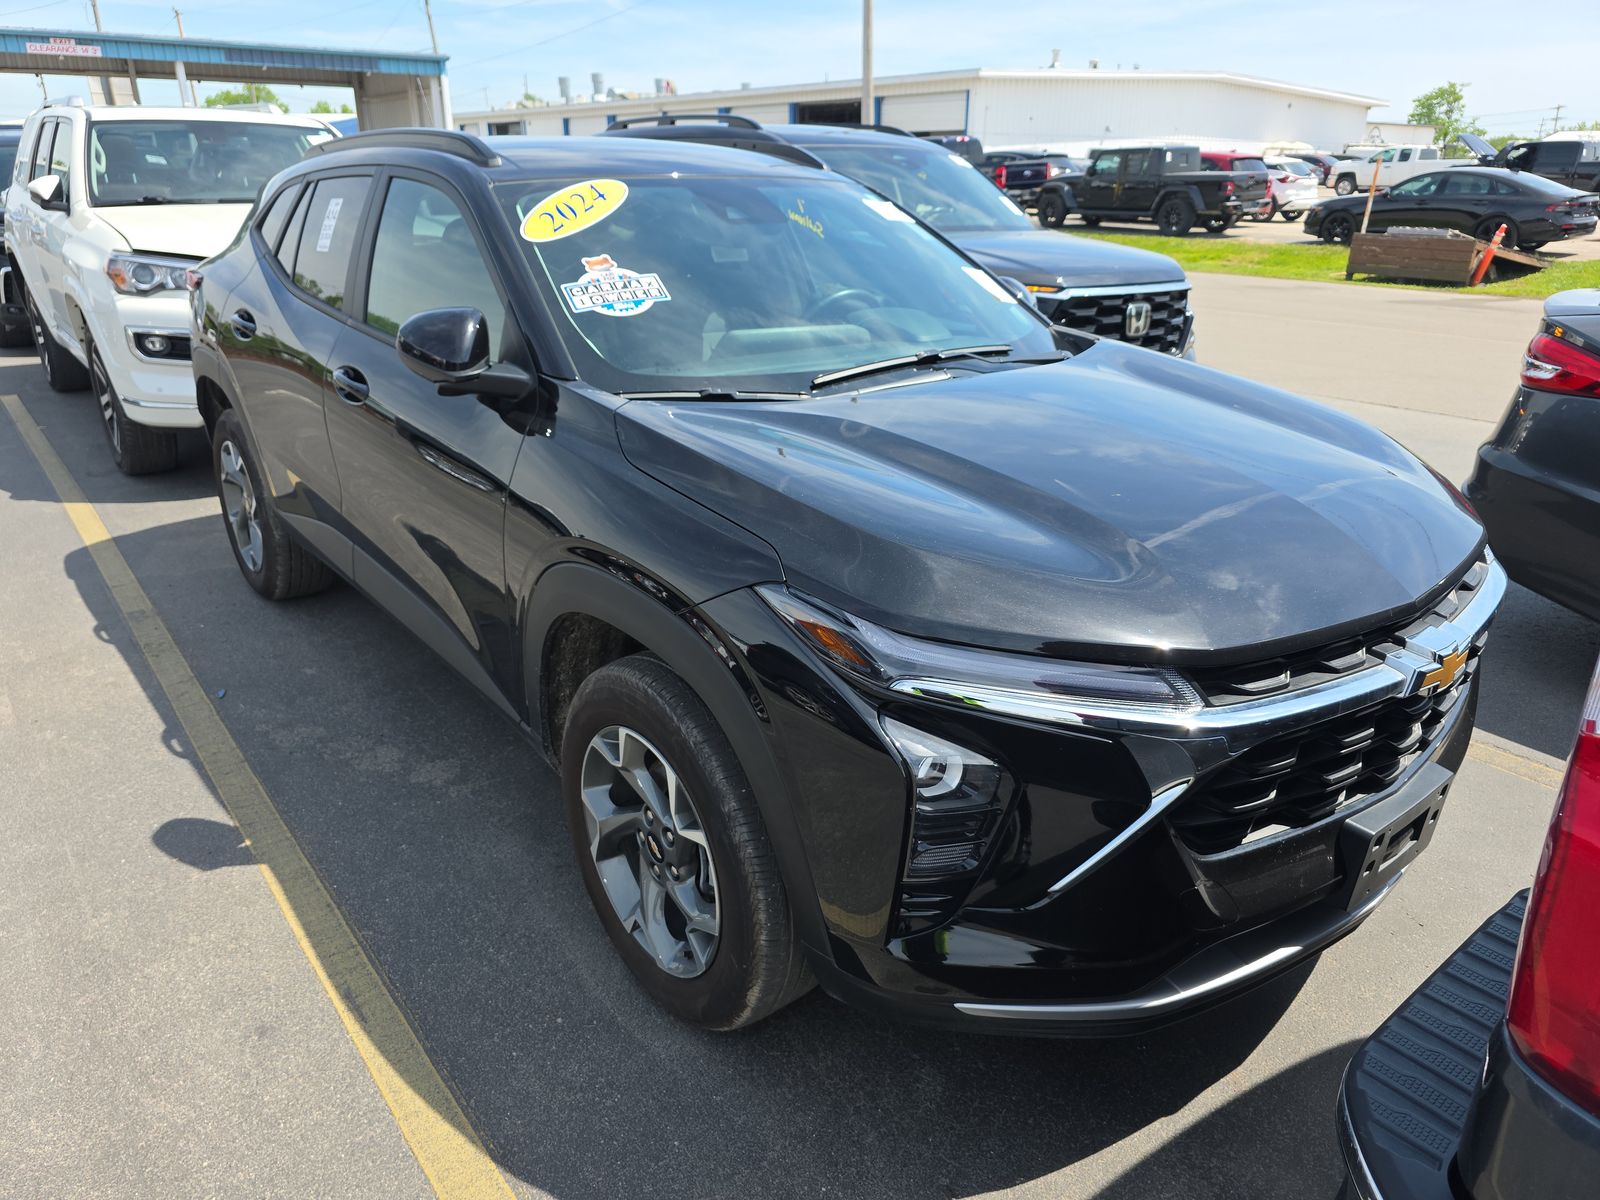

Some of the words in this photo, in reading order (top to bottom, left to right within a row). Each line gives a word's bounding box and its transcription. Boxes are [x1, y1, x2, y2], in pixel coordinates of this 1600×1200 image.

[29, 43, 79, 54] CLEARANCE
[539, 184, 607, 233] 2024
[570, 278, 656, 297] CARFAX
[590, 287, 664, 305] OWNER
